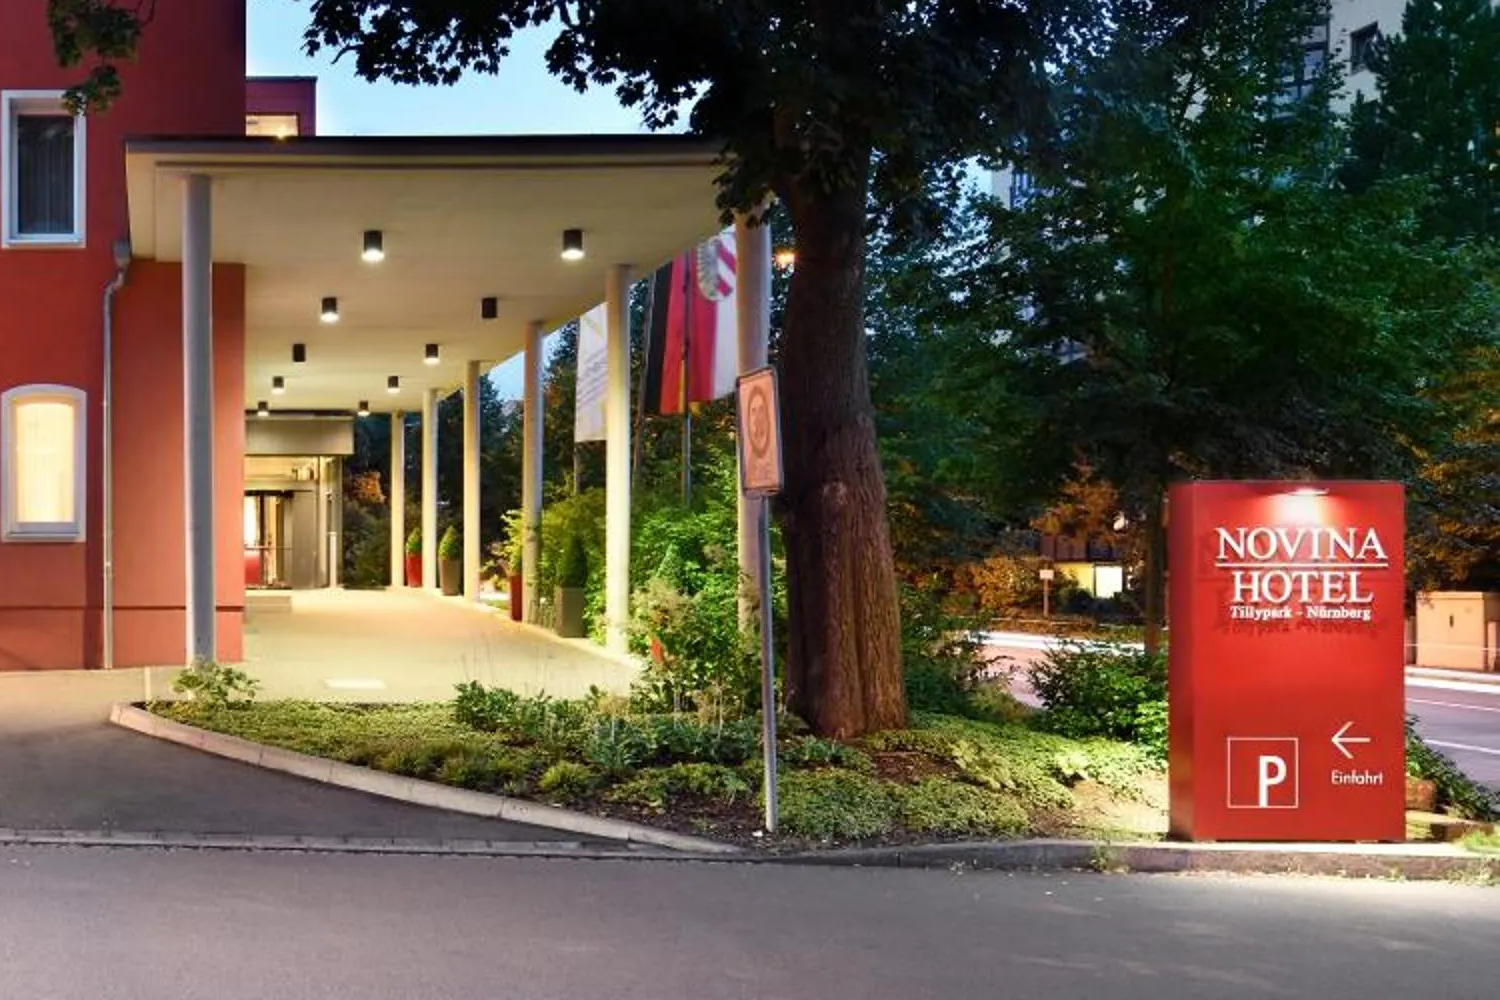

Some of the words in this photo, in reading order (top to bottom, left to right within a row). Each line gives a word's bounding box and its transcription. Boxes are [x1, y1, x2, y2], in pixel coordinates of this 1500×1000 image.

[1214, 527, 1388, 560] NOVINA
[1232, 570, 1374, 603] HOTEL
[1230, 605, 1292, 621] Tillypark
[1306, 605, 1371, 621] Nürnberg
[1258, 755, 1287, 808] P
[1331, 769, 1384, 785] Einfahrt
